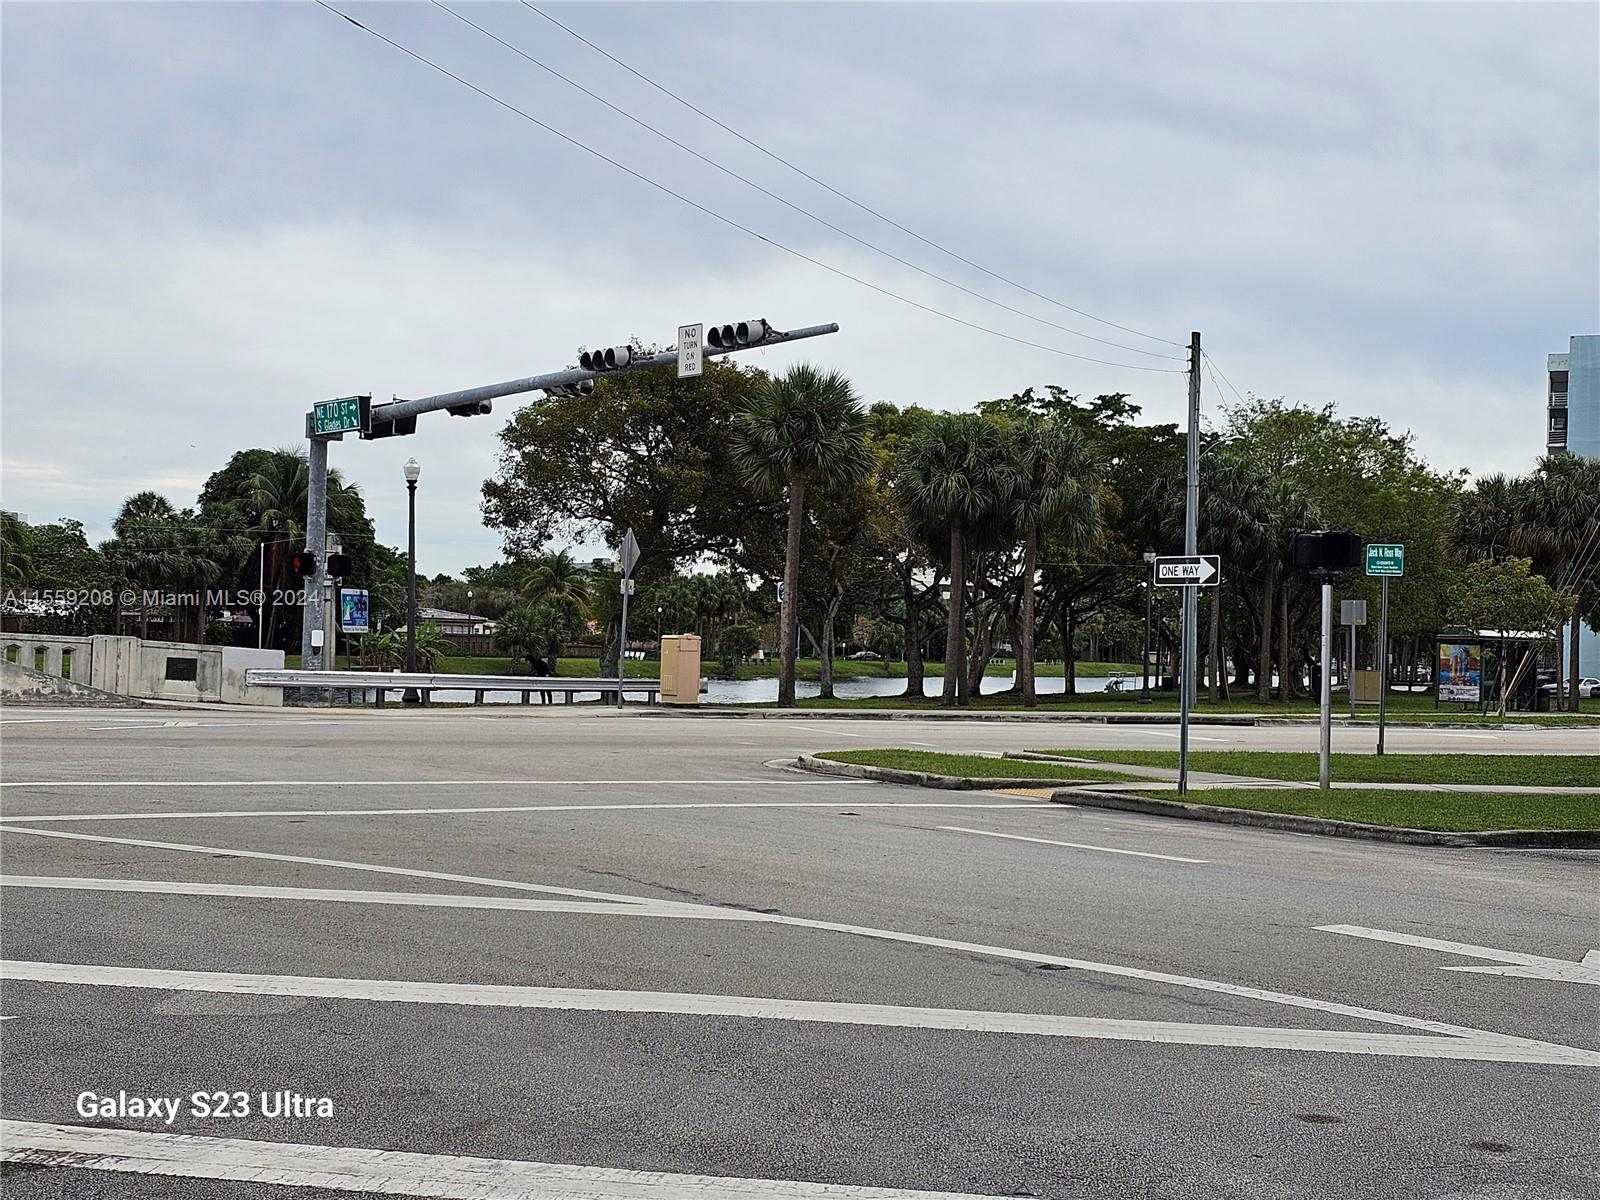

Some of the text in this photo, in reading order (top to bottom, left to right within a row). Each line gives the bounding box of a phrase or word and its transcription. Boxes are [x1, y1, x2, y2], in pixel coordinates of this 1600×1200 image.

[684, 328, 697, 339] NO
[683, 340, 698, 350] TURN
[685, 352, 695, 361] ON
[684, 362, 696, 372] RED
[316, 402, 348, 419] NE 170 ST
[317, 416, 350, 432] S Glades Dr
[1368, 547, 1378, 558] Jack
[1394, 547, 1403, 560] Way
[1161, 565, 1200, 577] ONE WAY
